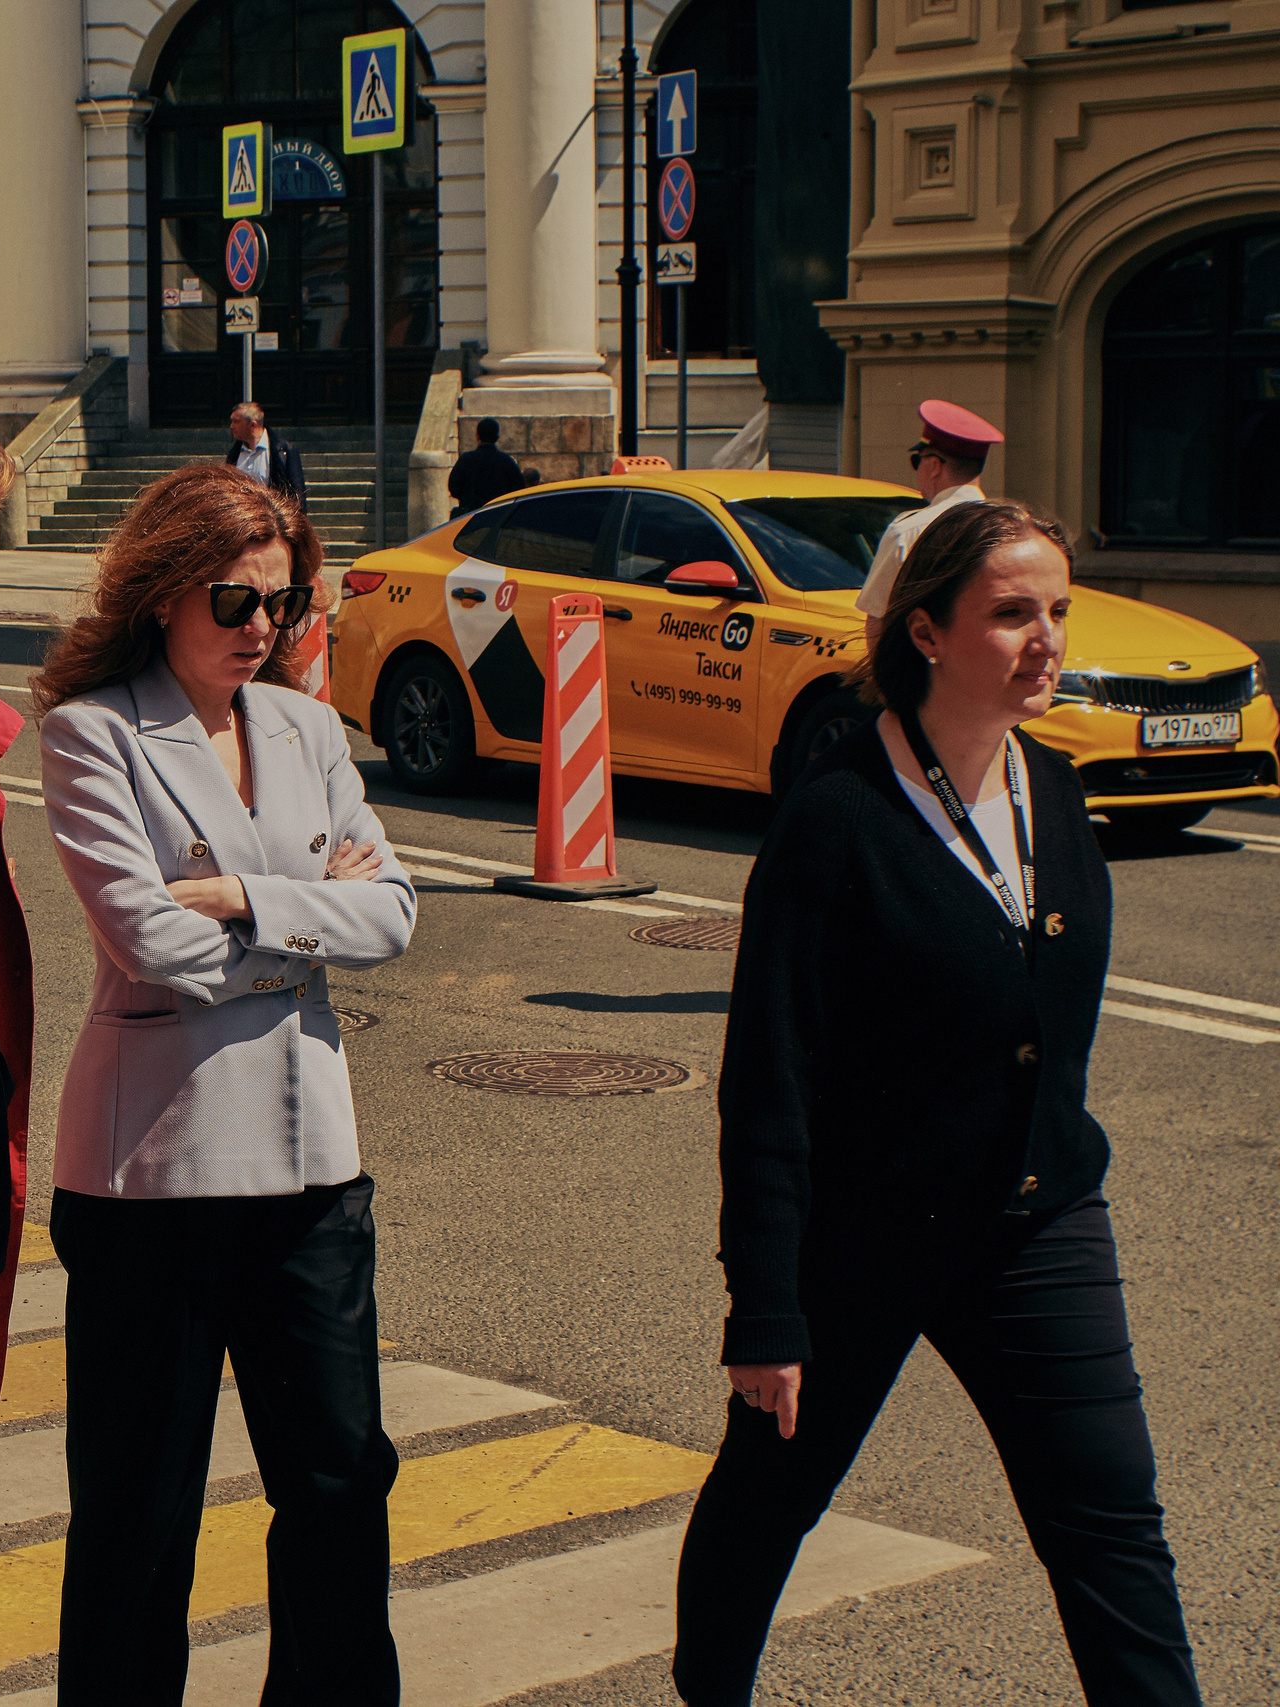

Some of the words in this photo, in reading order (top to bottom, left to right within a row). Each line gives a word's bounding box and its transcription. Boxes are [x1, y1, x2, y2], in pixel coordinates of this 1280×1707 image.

[273, 141, 313, 156] НЫЙ
[314, 152, 343, 192] ДВОР
[658, 612, 719, 642] Яндекс
[724, 619, 749, 645] Go
[696, 652, 742, 681] Такси
[645, 682, 676, 704] (495)
[679, 688, 742, 713] 999-99-99
[938, 779, 966, 819] RADISSON
[1022, 864, 1035, 906] RADISSON
[1000, 885, 1024, 926] RADISSON
